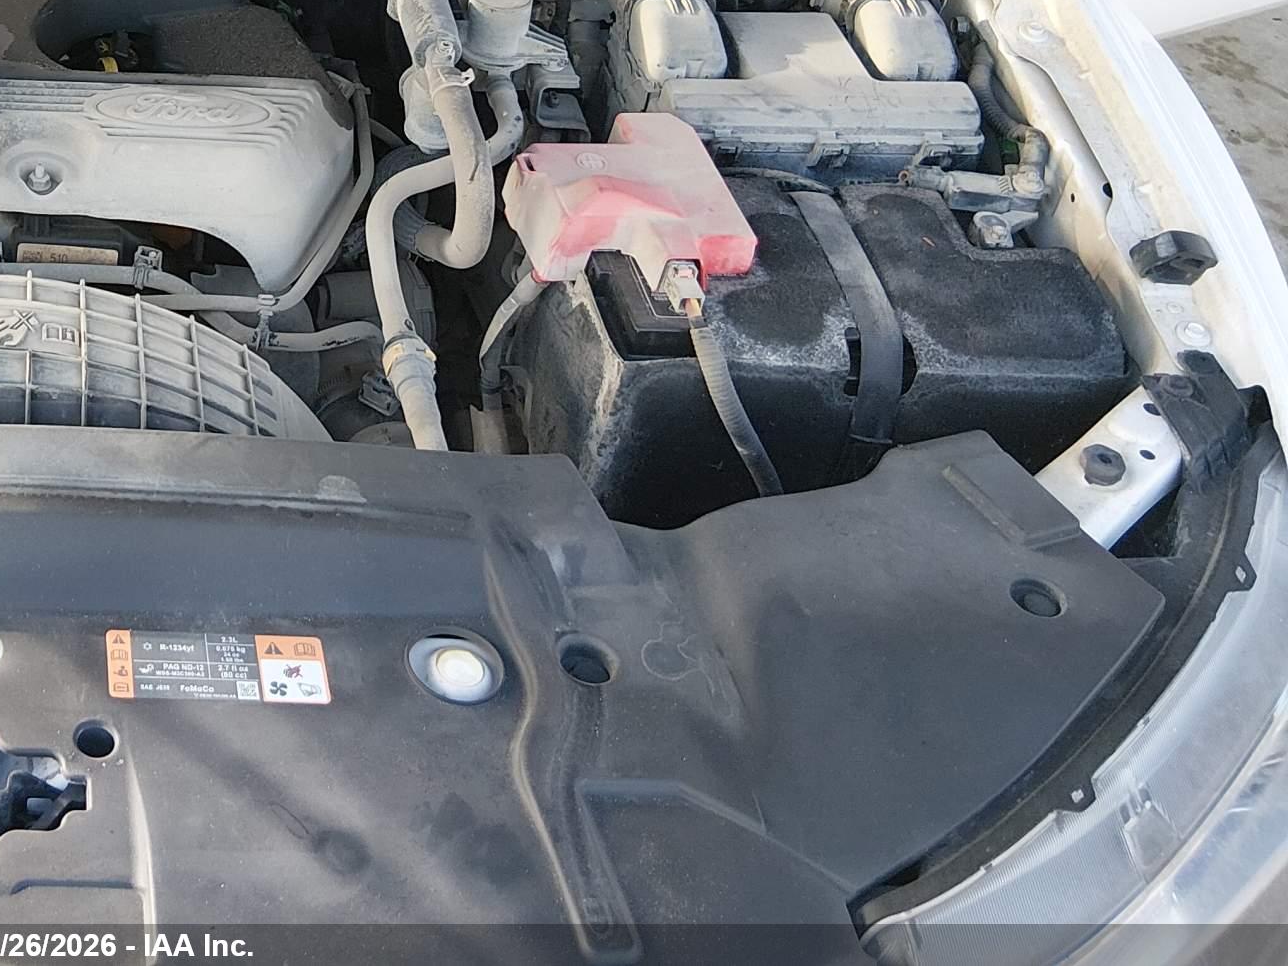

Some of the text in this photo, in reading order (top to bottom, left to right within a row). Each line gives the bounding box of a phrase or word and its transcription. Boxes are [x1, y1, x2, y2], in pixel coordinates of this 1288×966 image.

[126, 92, 242, 125] Ford
[159, 643, 195, 654] R-1234yf
[162, 663, 180, 671] PAG
[179, 684, 215, 693] FoMoCo
